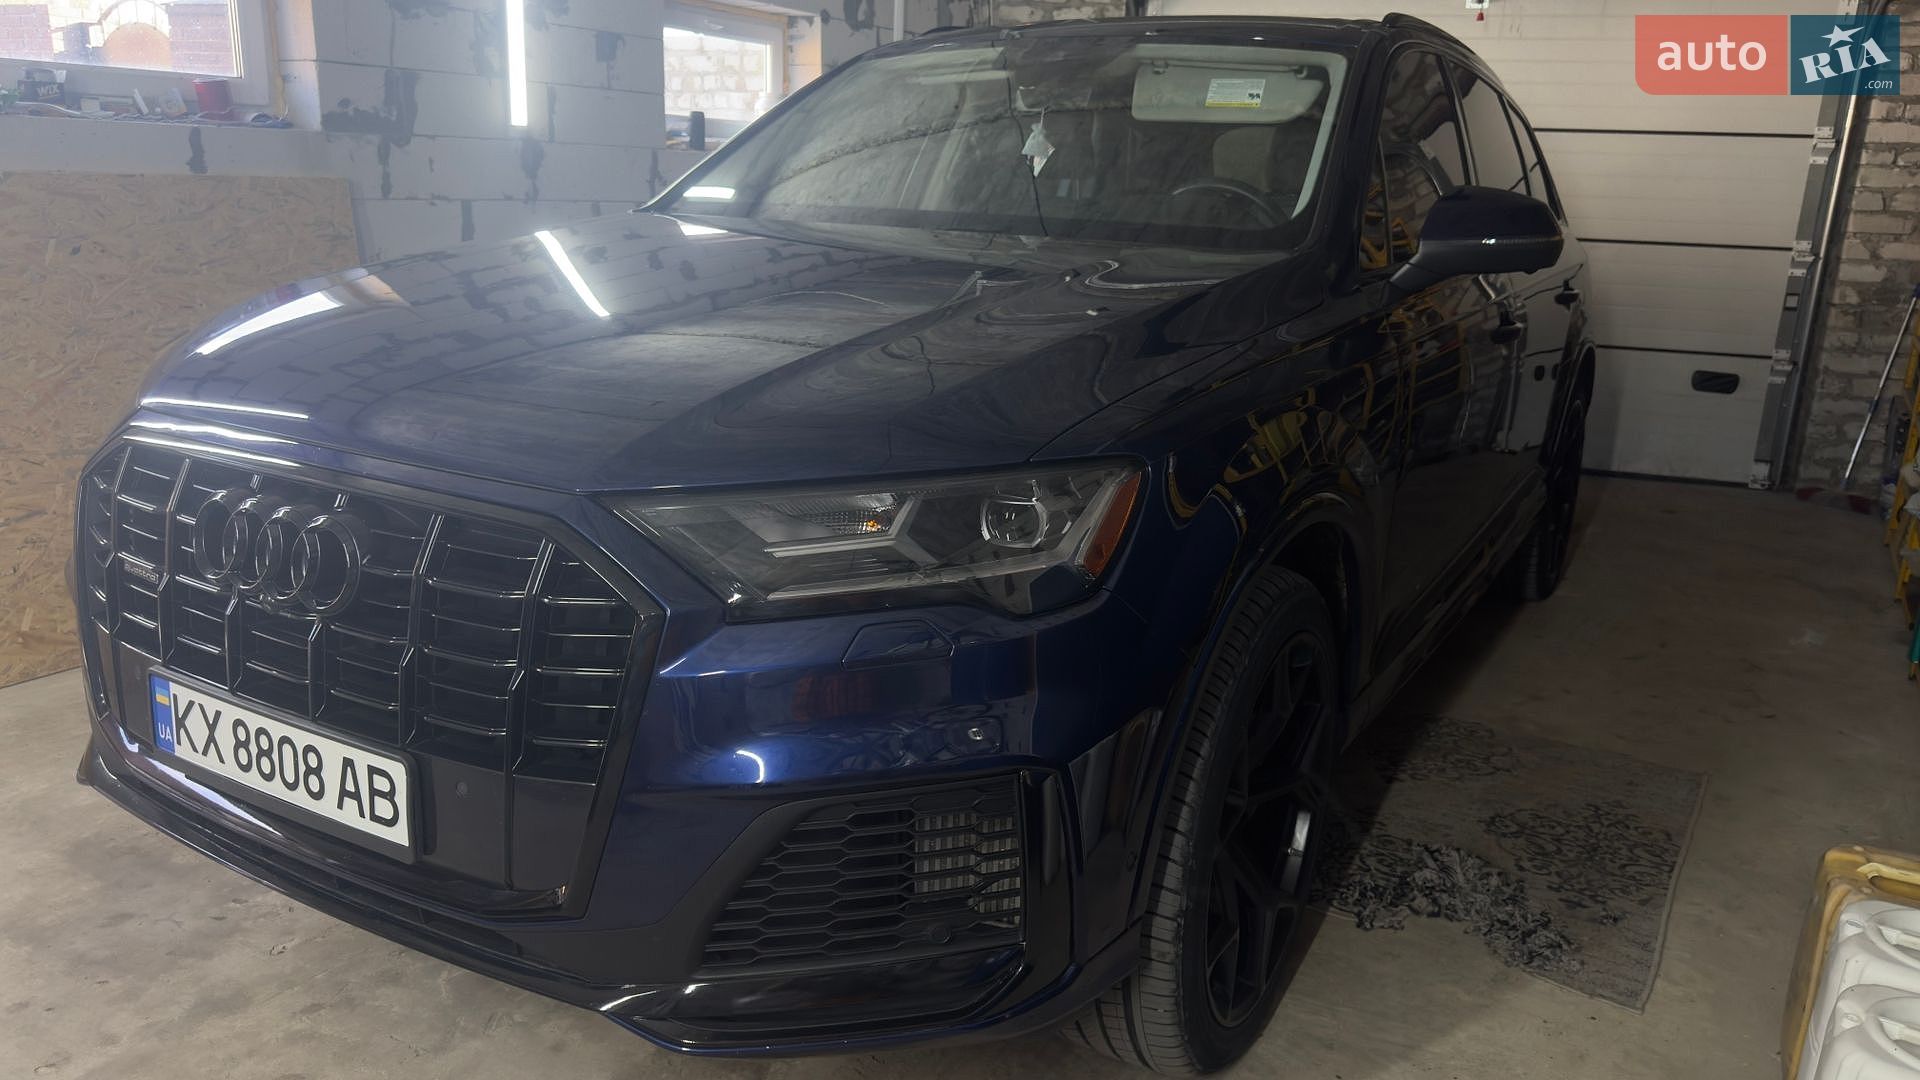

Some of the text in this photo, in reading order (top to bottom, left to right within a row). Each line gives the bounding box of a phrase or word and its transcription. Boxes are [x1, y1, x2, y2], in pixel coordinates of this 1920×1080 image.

[37, 84, 60, 97] WIX
[158, 722, 173, 742] UA
[172, 693, 400, 828] KX 8808 AB
